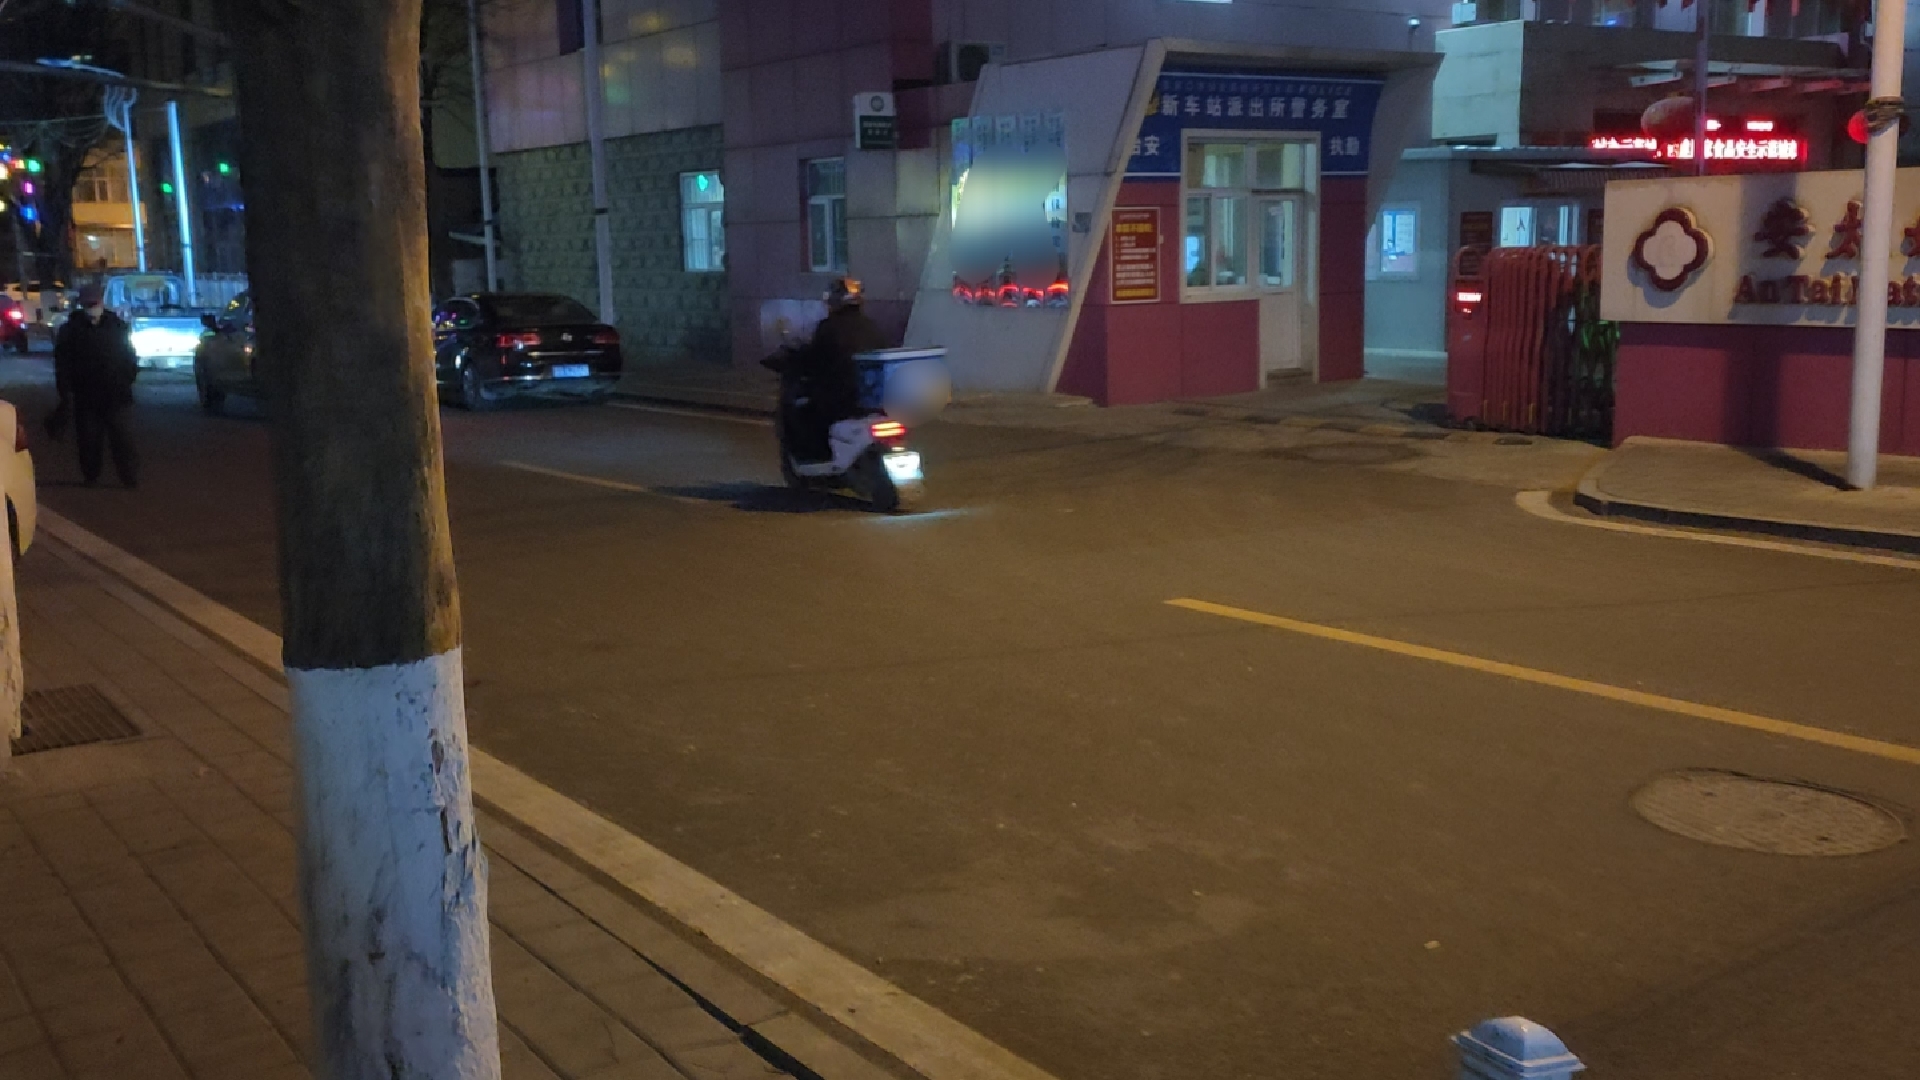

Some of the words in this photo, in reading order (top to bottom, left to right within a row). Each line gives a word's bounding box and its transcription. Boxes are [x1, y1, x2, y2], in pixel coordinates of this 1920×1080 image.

[1161, 94, 1350, 119] 新车站派出所警务室
[1330, 135, 1361, 156] 执勤
